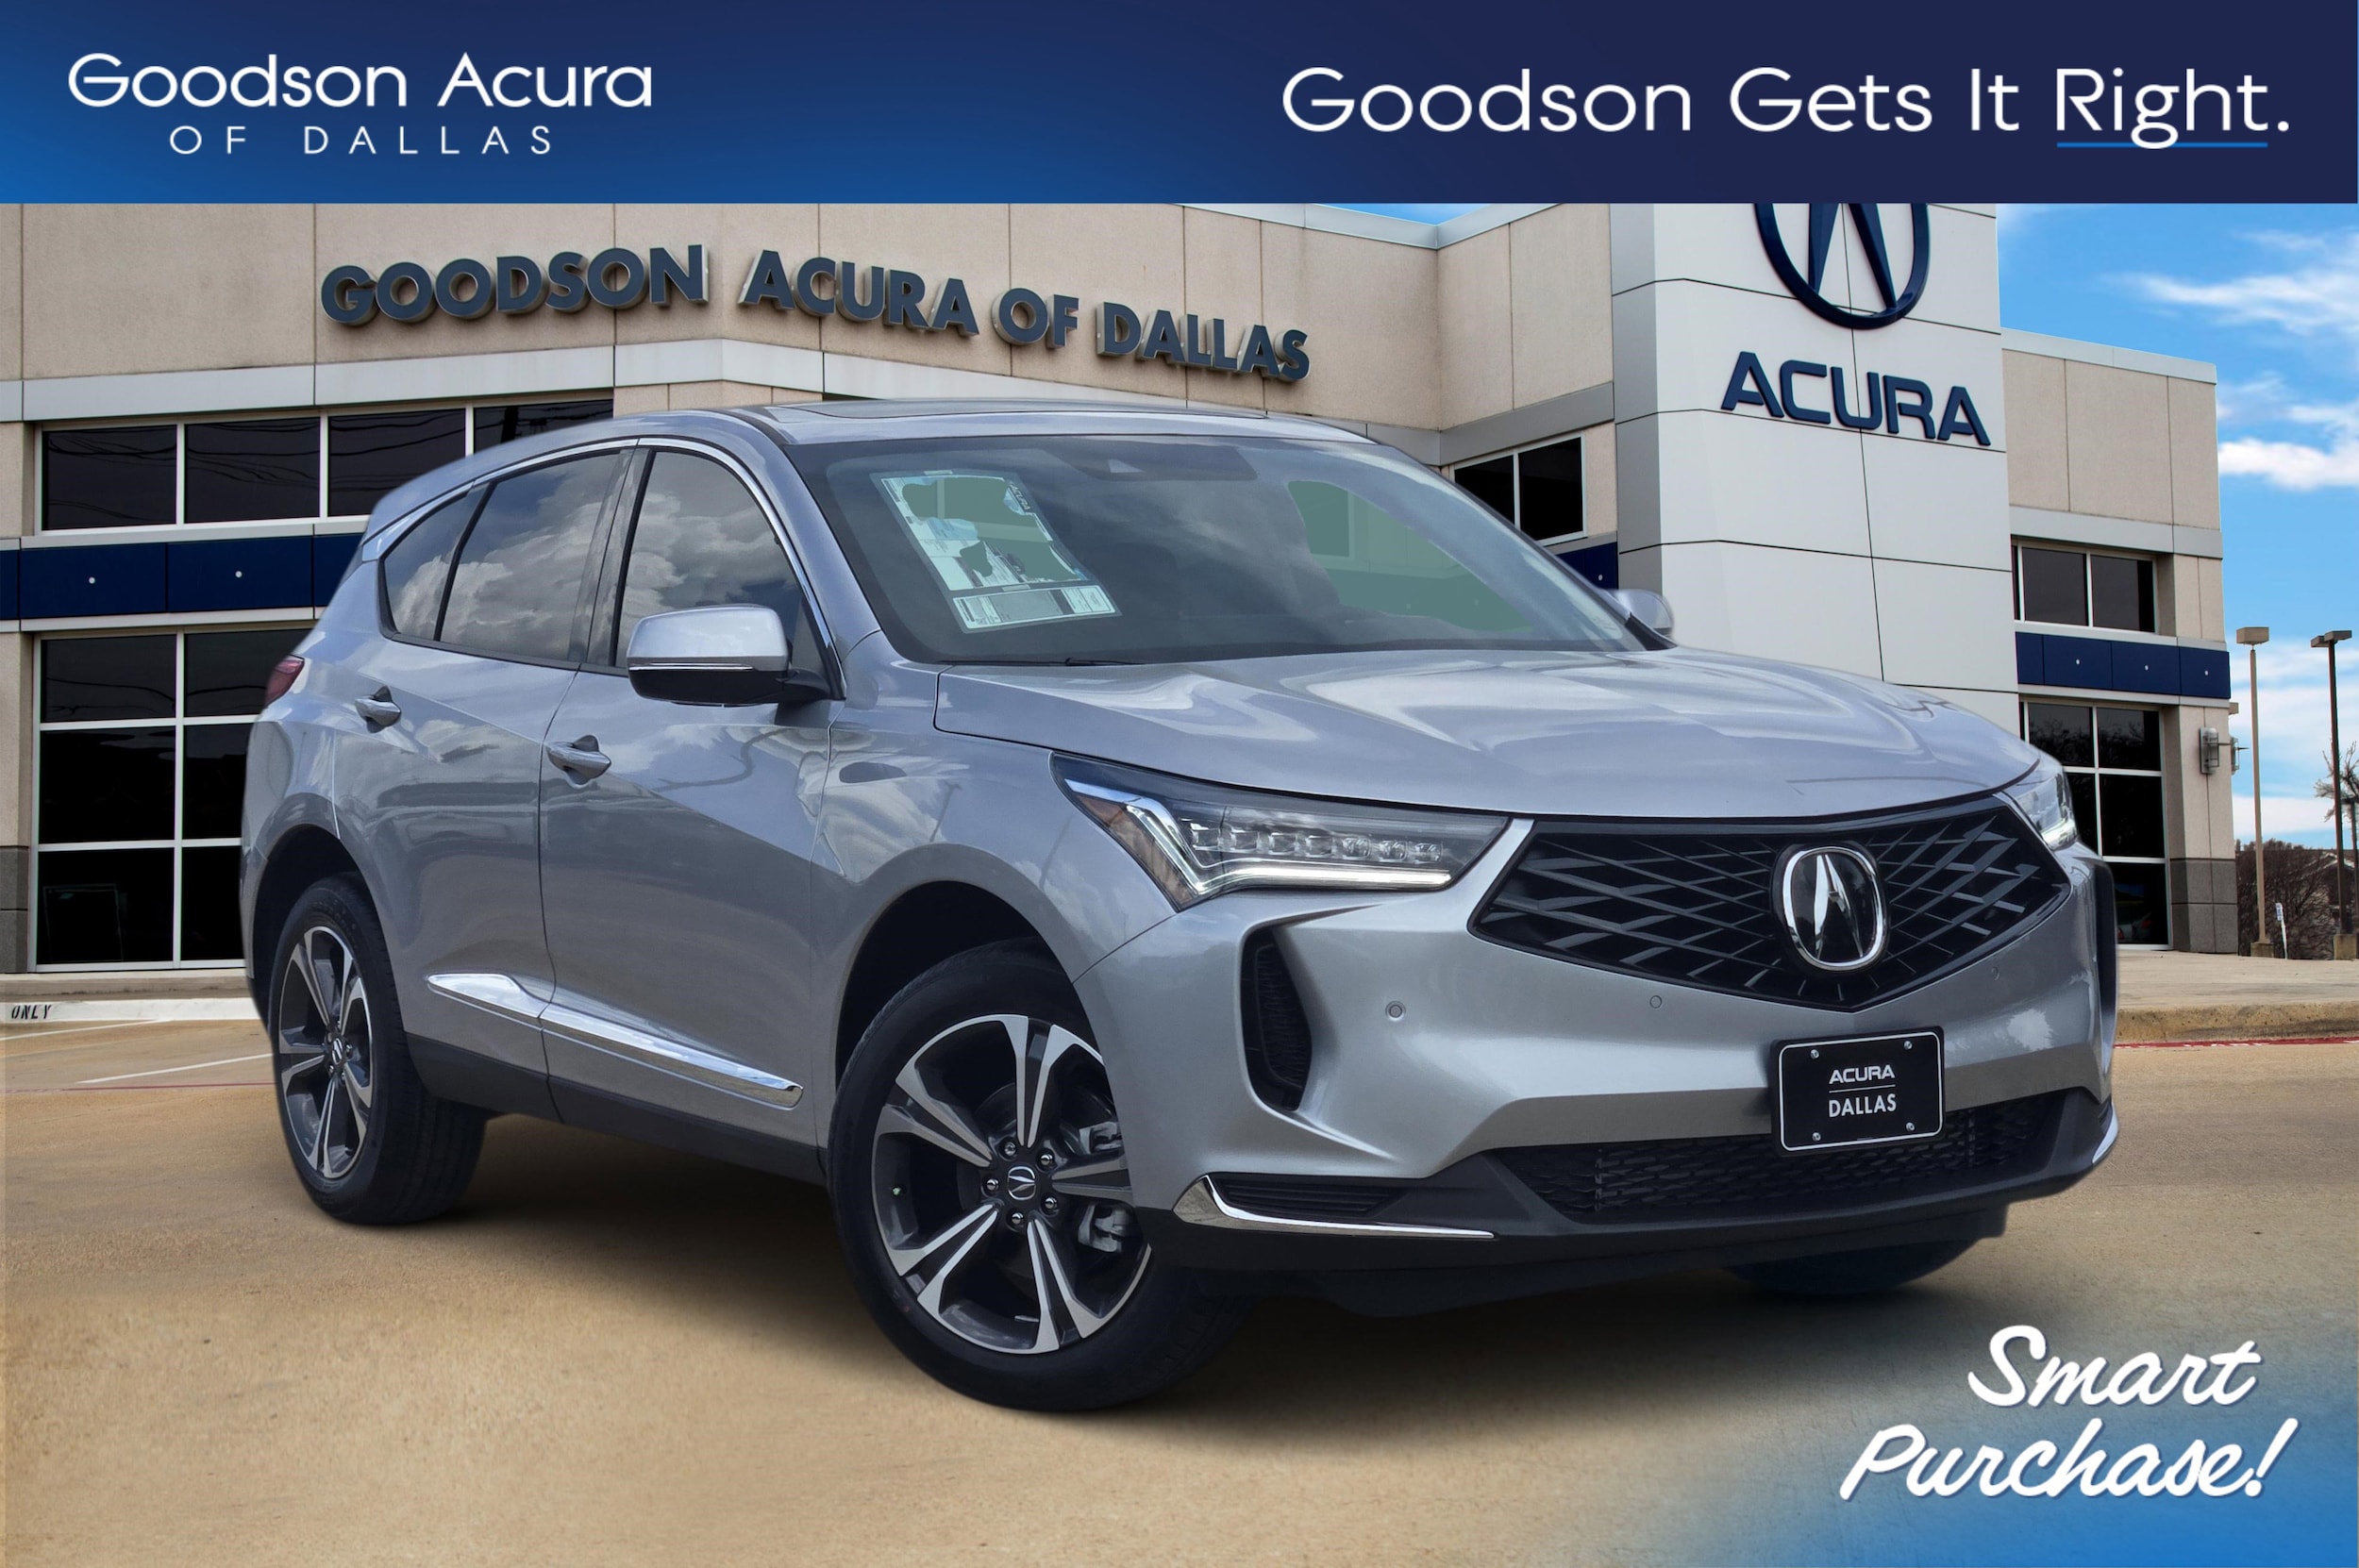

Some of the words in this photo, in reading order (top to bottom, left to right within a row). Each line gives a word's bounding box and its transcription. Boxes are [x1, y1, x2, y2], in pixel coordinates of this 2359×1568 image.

[321, 243, 709, 327] GOODSON
[739, 249, 979, 336] ACURA
[992, 288, 1079, 349] OF
[1096, 301, 1310, 381] DALLAS
[1720, 351, 1991, 446] ACURA
[11, 1004, 52, 1020] ONLY
[1829, 1064, 1896, 1085] ACURA
[1829, 1093, 1897, 1118] DALLAS
